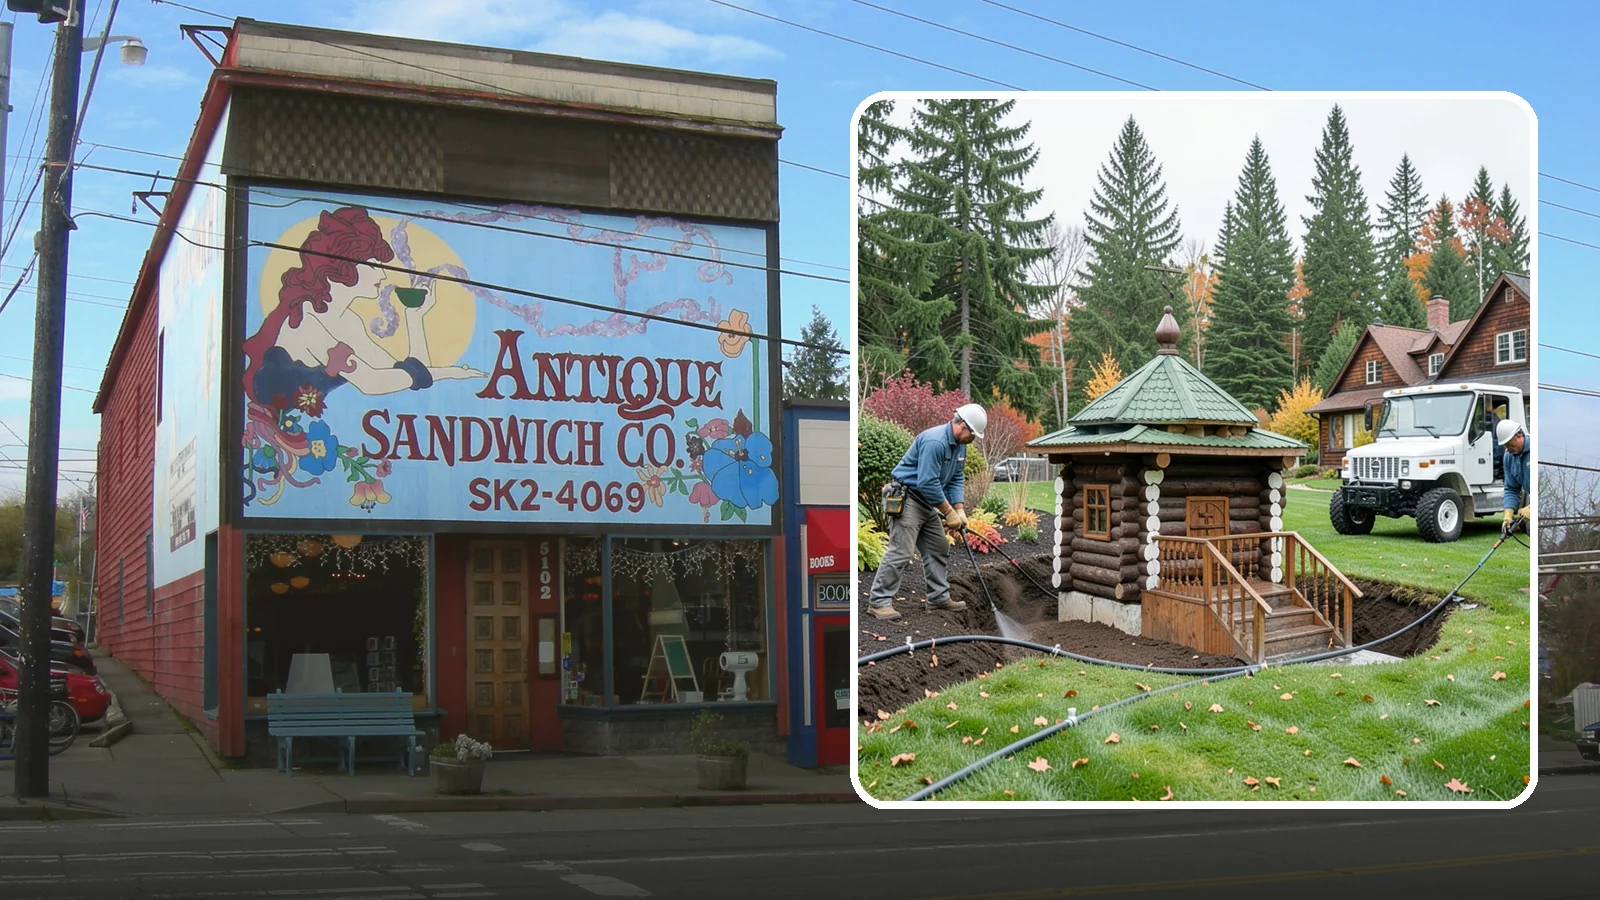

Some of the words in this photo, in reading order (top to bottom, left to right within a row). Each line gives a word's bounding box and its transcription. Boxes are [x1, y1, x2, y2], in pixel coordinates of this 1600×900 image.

[476, 329, 723, 421] ANTIQUE
[361, 408, 605, 467] SANDWICH
[617, 421, 685, 470] CO.
[468, 477, 645, 513] SK2-4069
[539, 541, 552, 600] 5102
[809, 554, 835, 569] BOOKS
